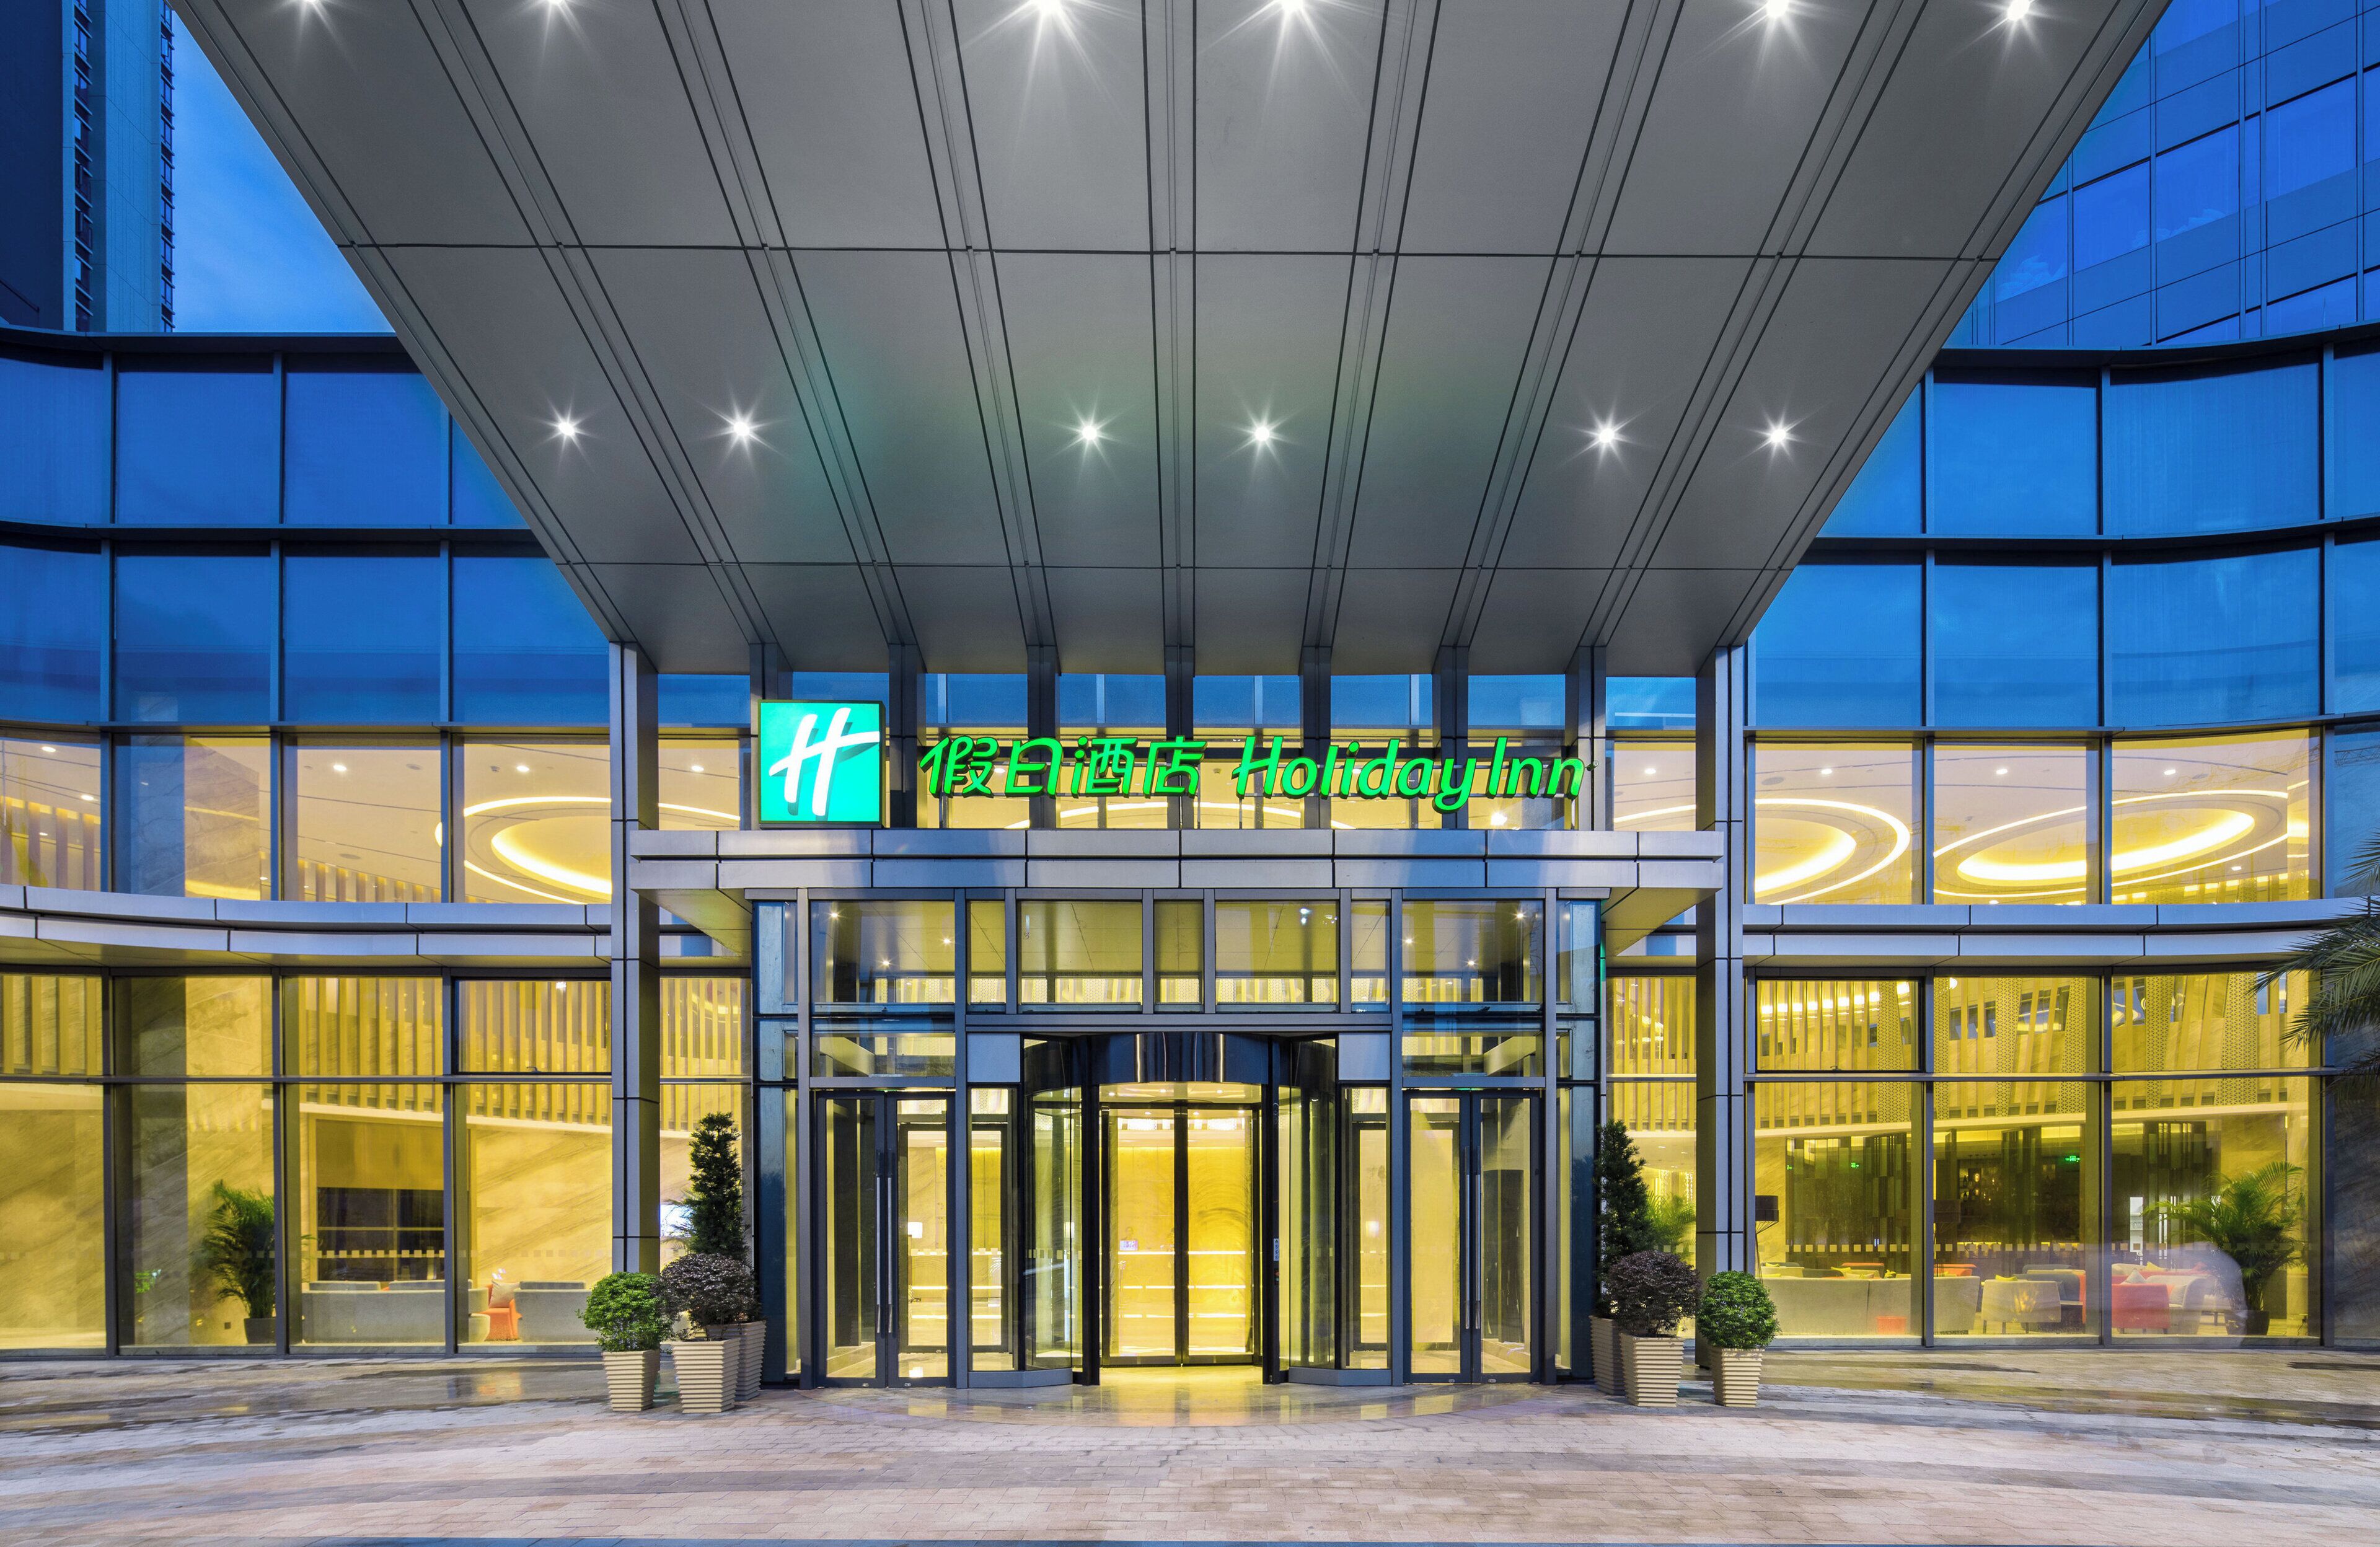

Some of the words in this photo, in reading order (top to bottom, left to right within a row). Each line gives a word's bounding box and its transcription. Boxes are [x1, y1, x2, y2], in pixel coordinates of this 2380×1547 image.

[919, 736, 1207, 797] 假日酒店
[1232, 736, 1477, 812] Holiday
[1488, 737, 1585, 798] Inn
